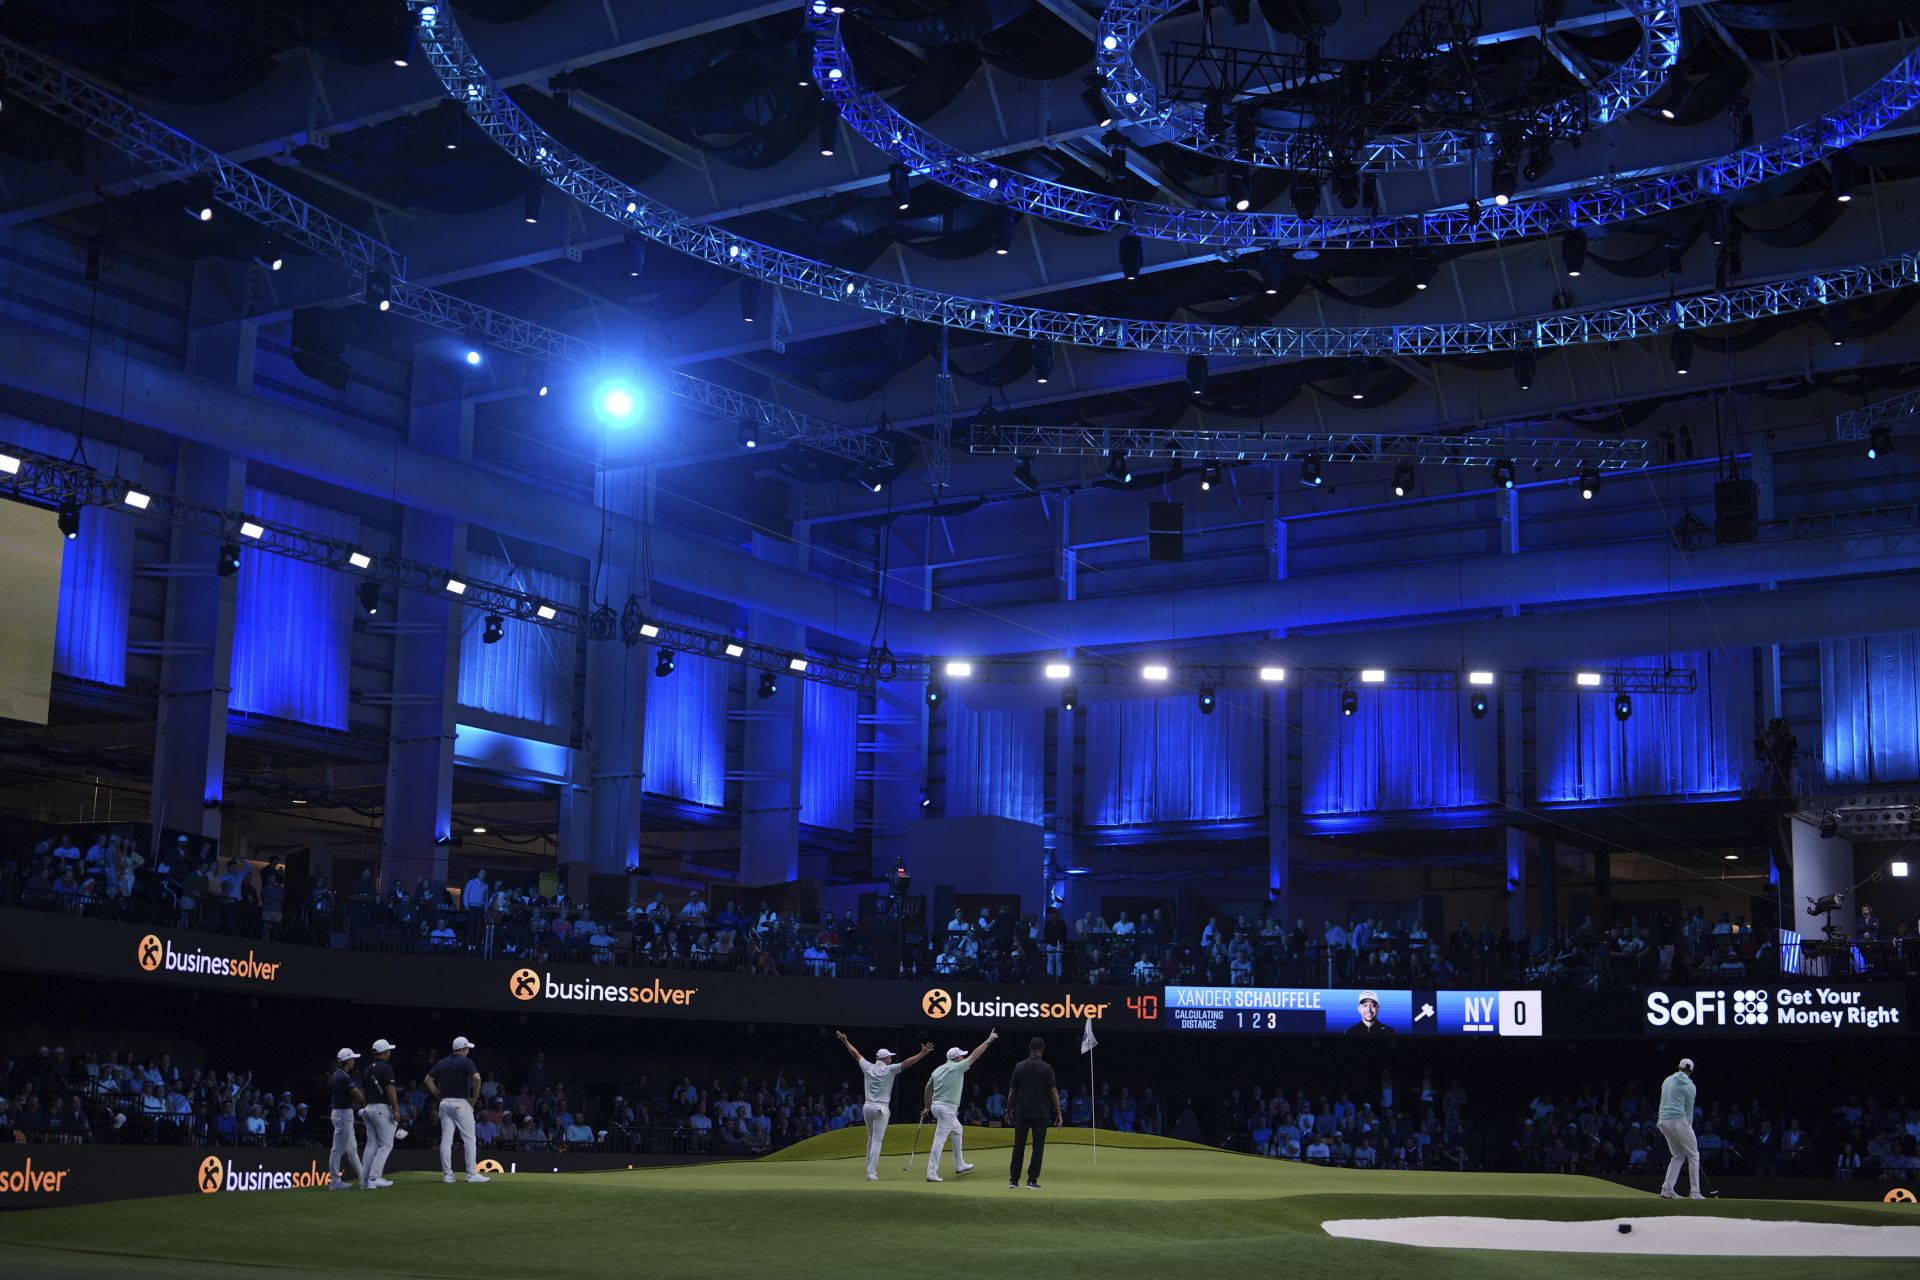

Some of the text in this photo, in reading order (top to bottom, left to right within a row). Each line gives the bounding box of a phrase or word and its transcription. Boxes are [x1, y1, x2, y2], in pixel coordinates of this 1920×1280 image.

[165, 940, 280, 981] businessolver
[545, 972, 696, 1005] businessolver
[1177, 989, 1321, 1009] XANDER SCHAUFFELE
[1777, 987, 1861, 1006] Get Your
[956, 992, 1107, 1018] businessolver
[1126, 995, 1158, 1020] 40
[1174, 1009, 1224, 1020] CALCULATING
[1463, 997, 1495, 1023] NY
[1514, 1000, 1527, 1026] 0
[1646, 990, 1726, 1026] SoFi
[1777, 1006, 1900, 1029] Money Right
[1181, 1019, 1218, 1030] DISTANCE
[1236, 1012, 1277, 1030] 1 2 3
[225, 1159, 343, 1191] businessolve
